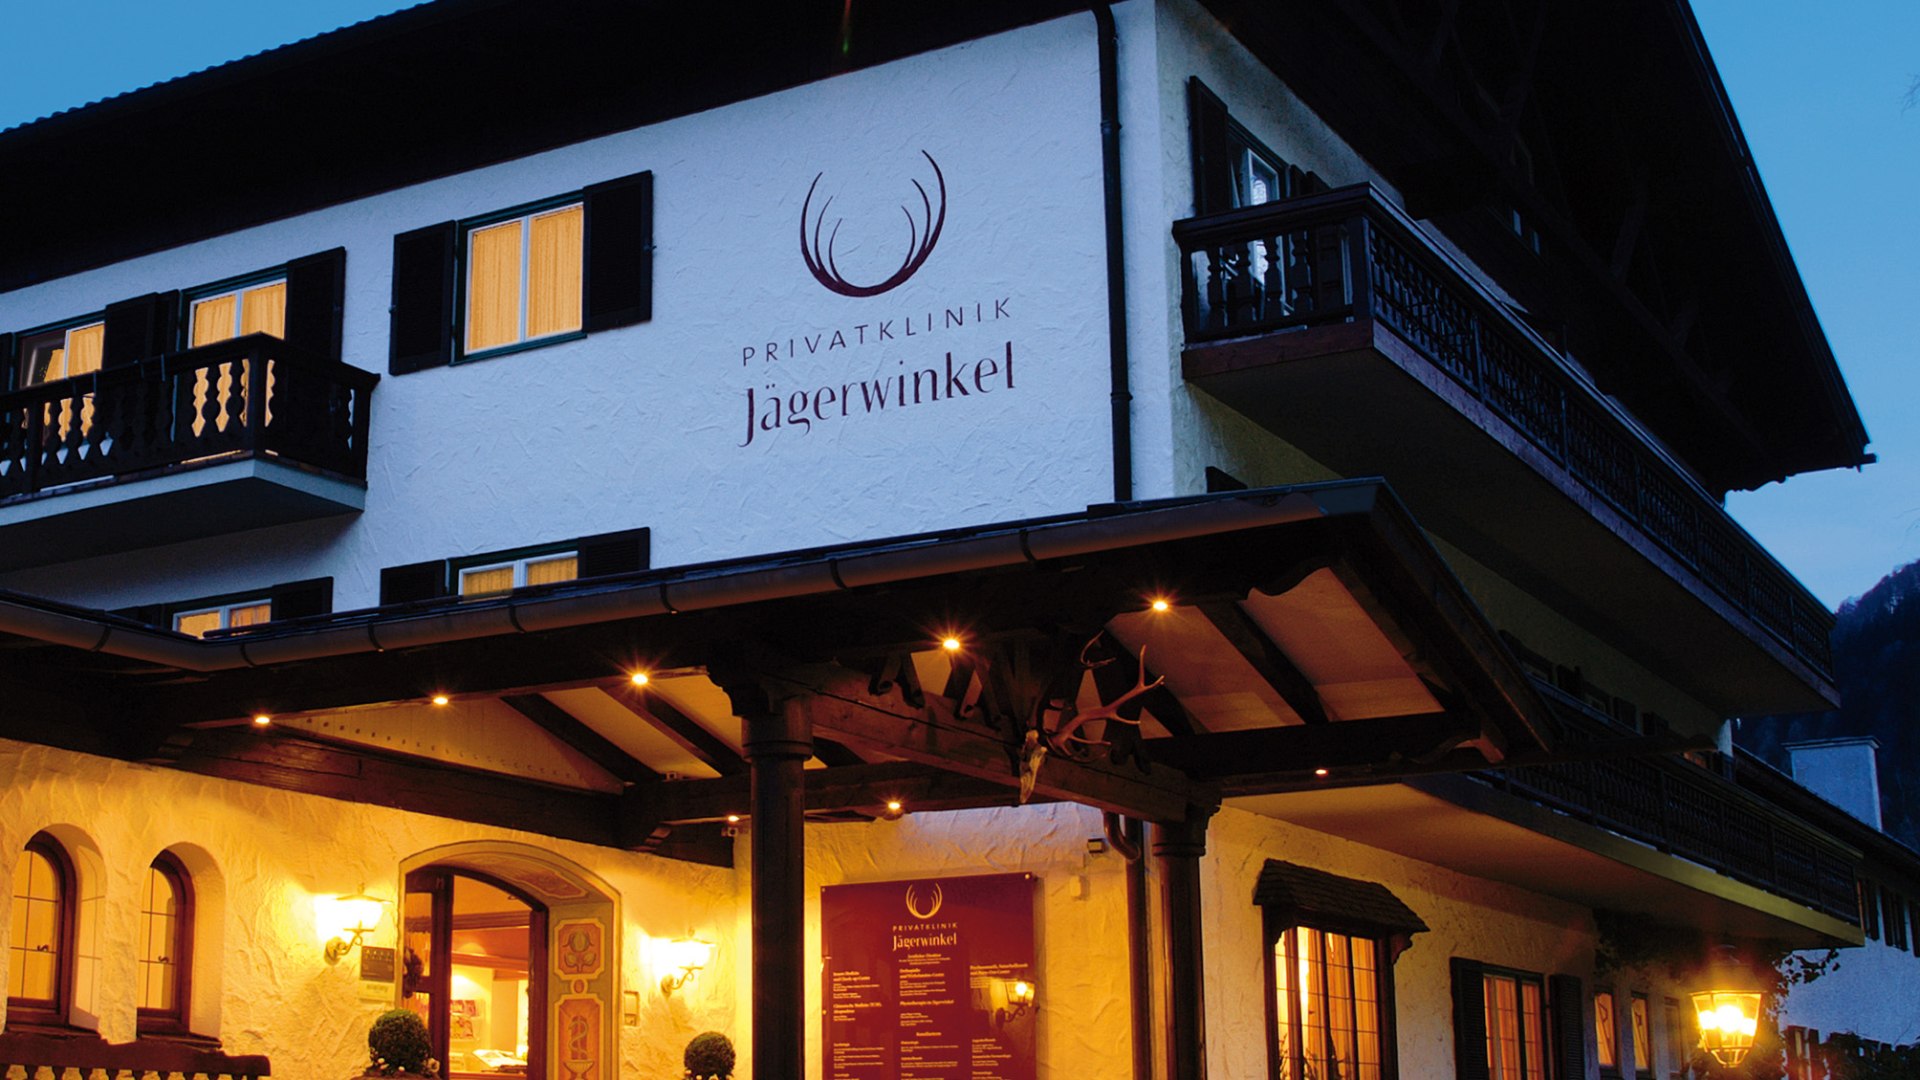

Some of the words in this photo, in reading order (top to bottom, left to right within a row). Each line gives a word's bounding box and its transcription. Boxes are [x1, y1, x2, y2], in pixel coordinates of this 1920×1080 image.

[742, 297, 1011, 367] PRIVATKLINIK
[737, 340, 1016, 448] Jägerwinkel
[892, 922, 958, 932] PRIVATKLINIK
[892, 932, 957, 952] Jägerwinkel
